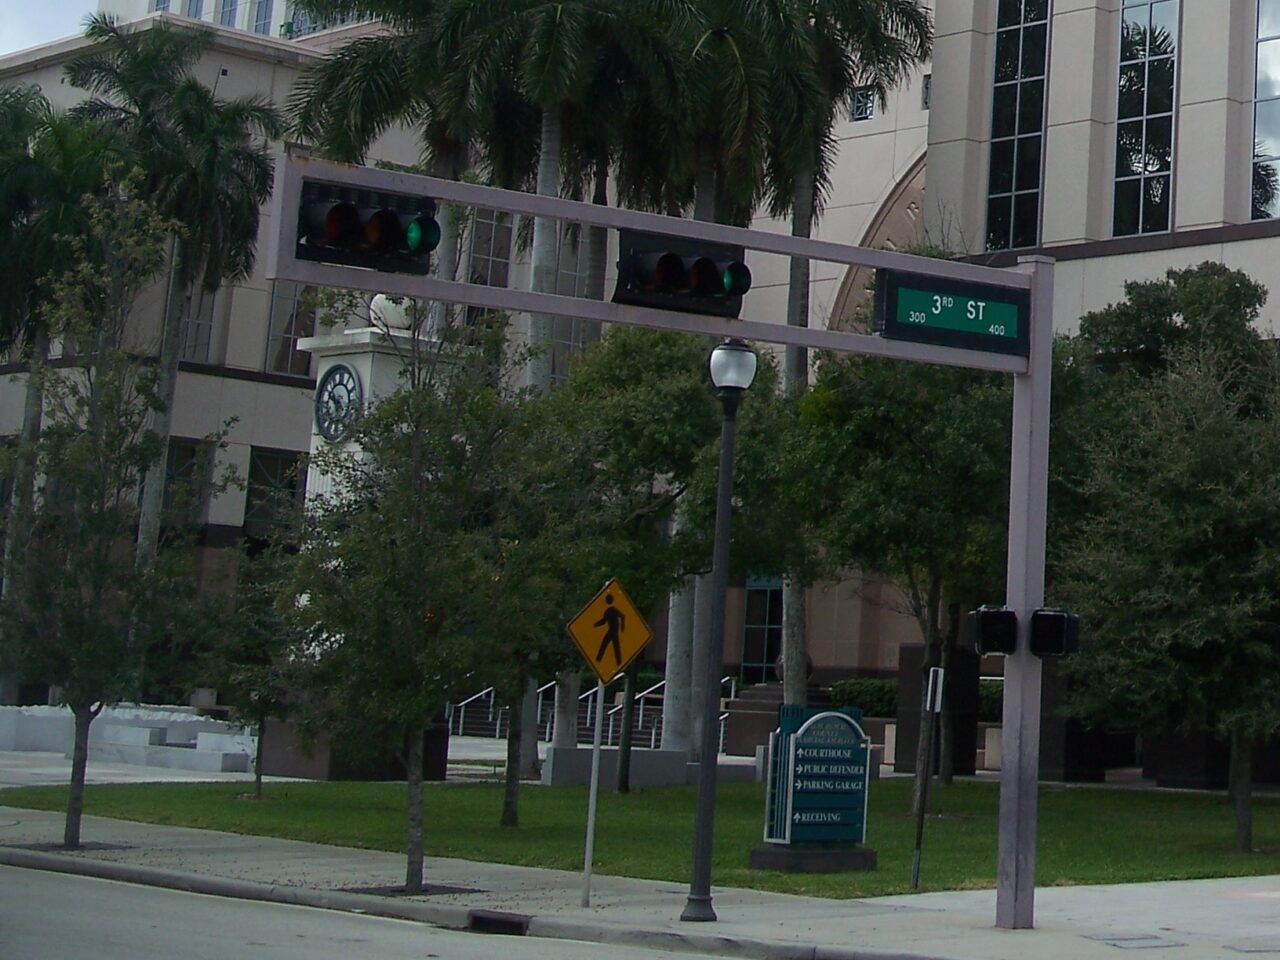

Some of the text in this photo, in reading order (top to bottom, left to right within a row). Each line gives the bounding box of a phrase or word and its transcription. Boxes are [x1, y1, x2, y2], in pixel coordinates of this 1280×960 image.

[932, 295, 986, 320] 3RD ST
[909, 311, 926, 323] 300
[988, 324, 1005, 336] 400
[804, 748, 852, 758] COURTHOUSE
[803, 764, 864, 774] PUBLIC DEFENDER
[802, 780, 864, 790] PARKING GARAGE
[801, 812, 841, 822] RECEIVING
